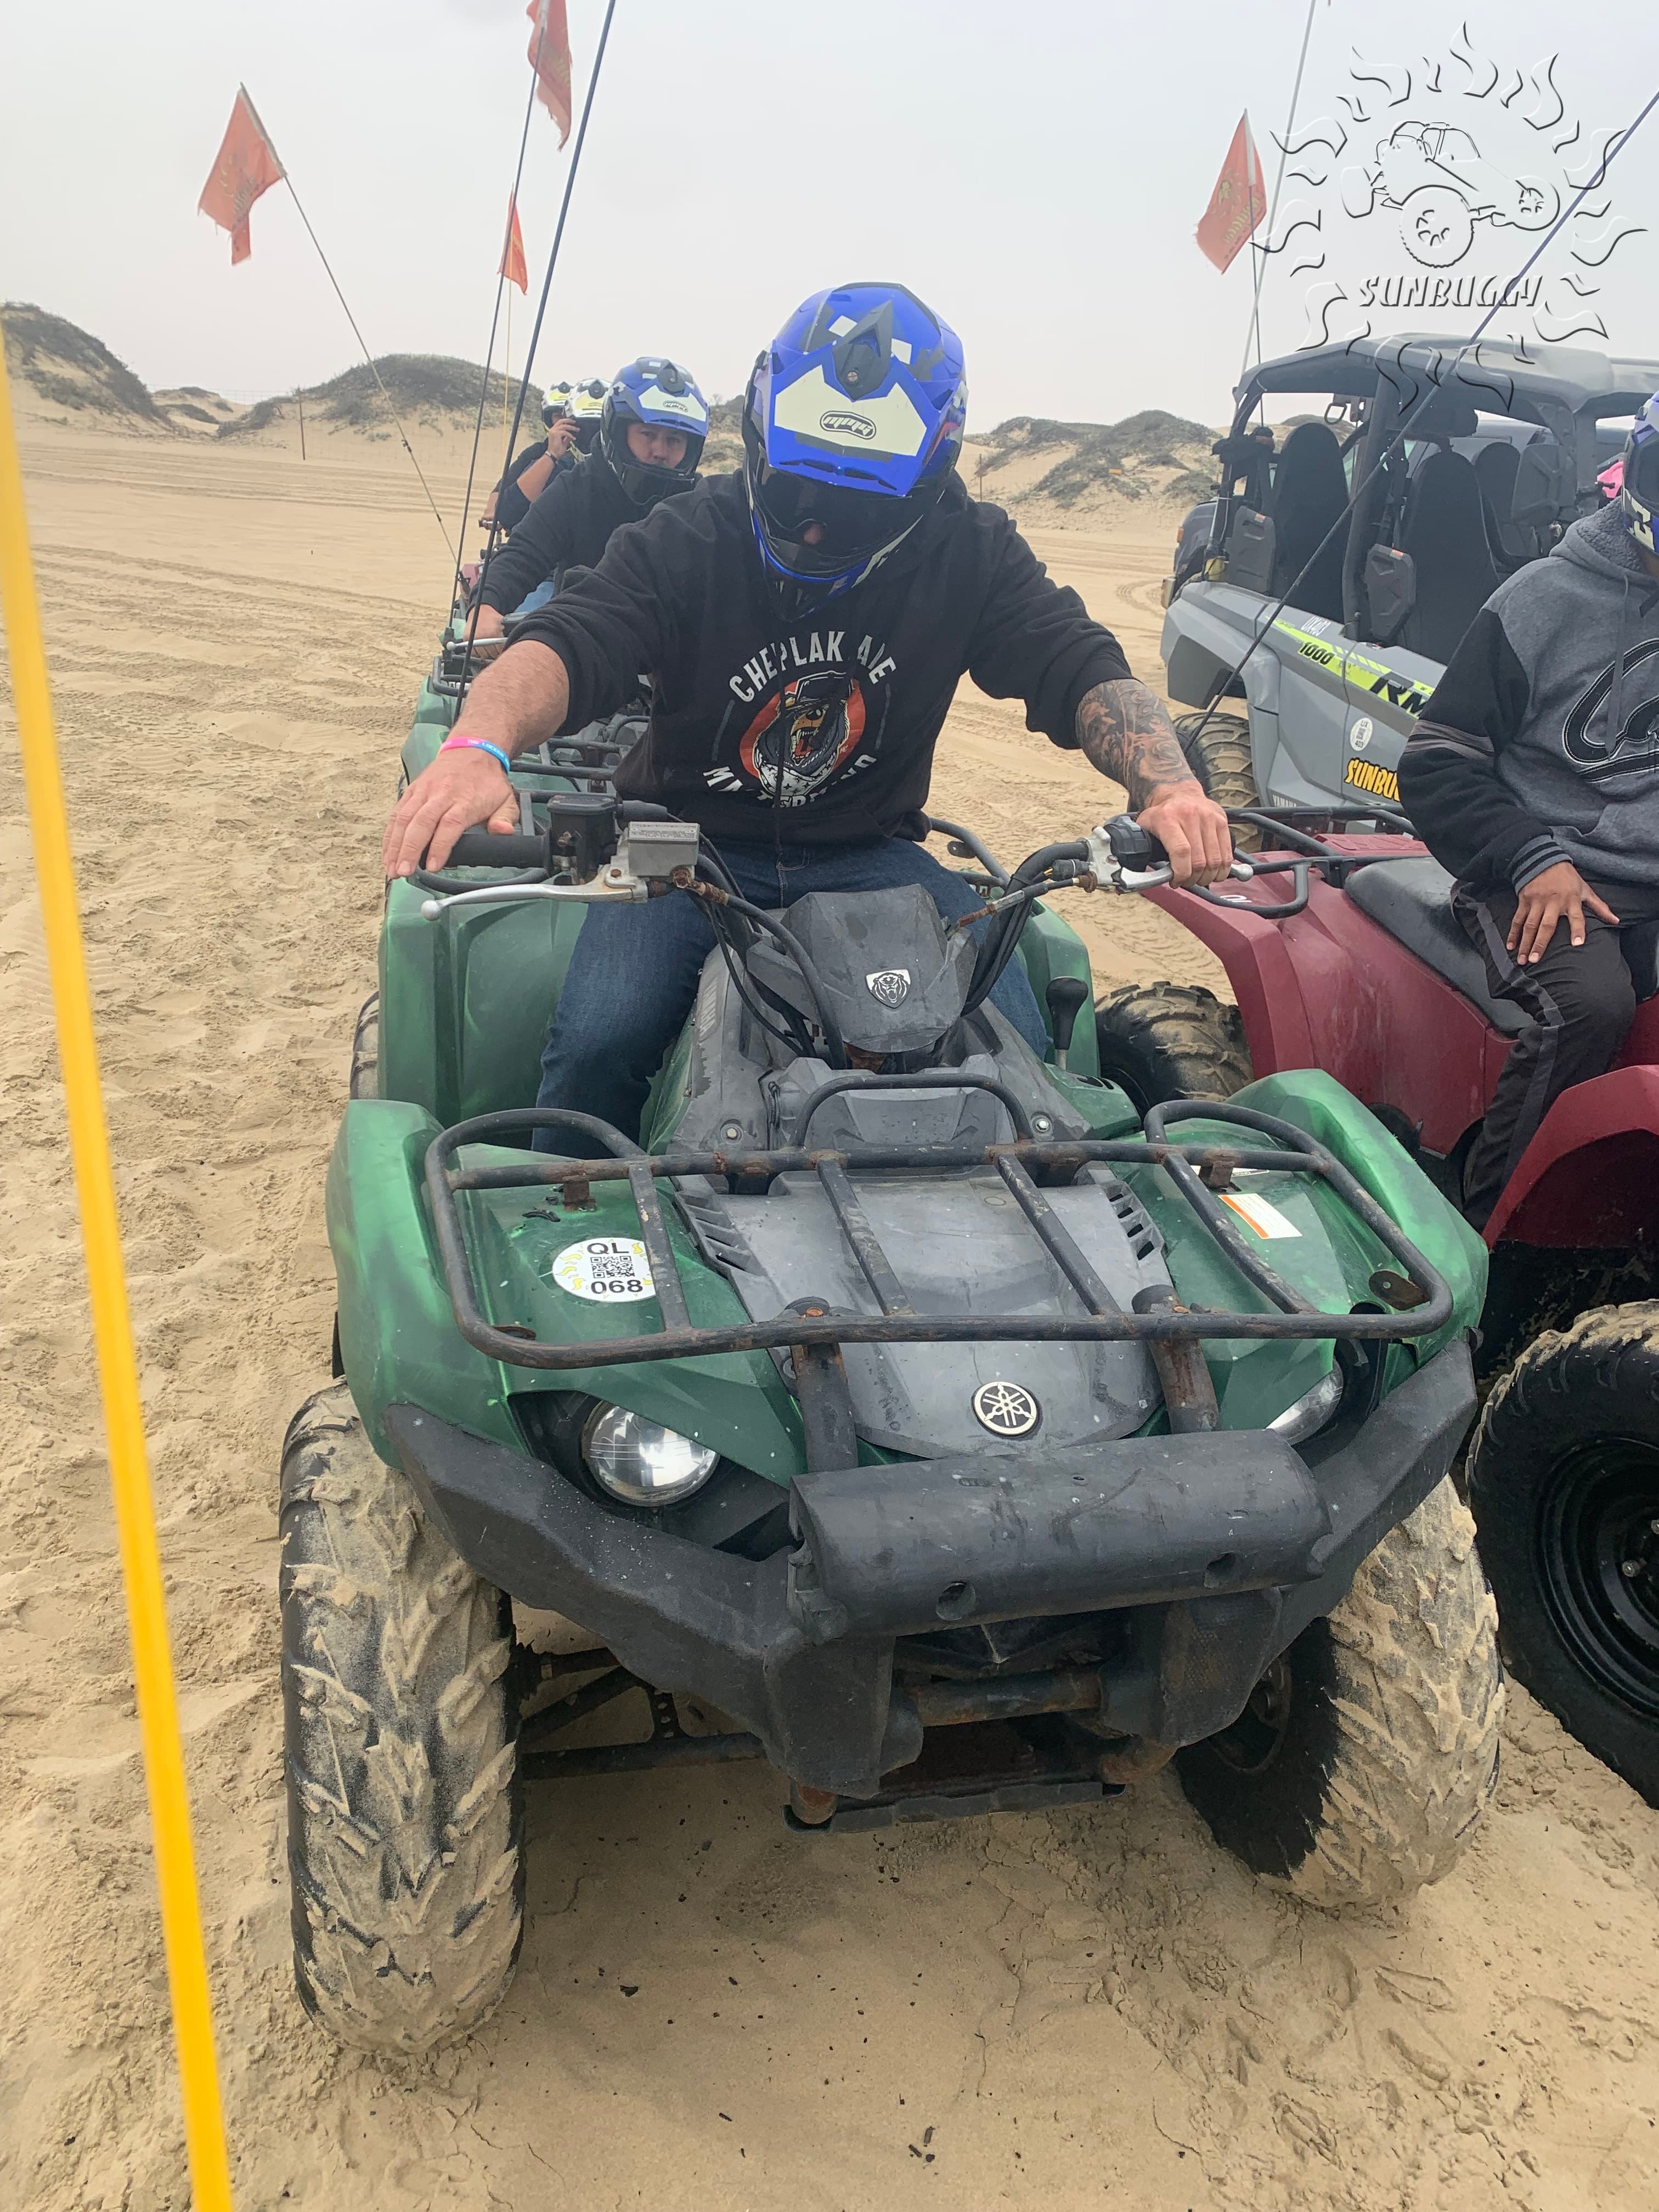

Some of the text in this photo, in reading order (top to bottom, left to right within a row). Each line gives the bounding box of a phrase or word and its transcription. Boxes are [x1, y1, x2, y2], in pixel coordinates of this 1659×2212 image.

[1299, 642, 1336, 665] 1000
[586, 1242, 629, 1255] QL
[590, 1279, 644, 1294] 068
